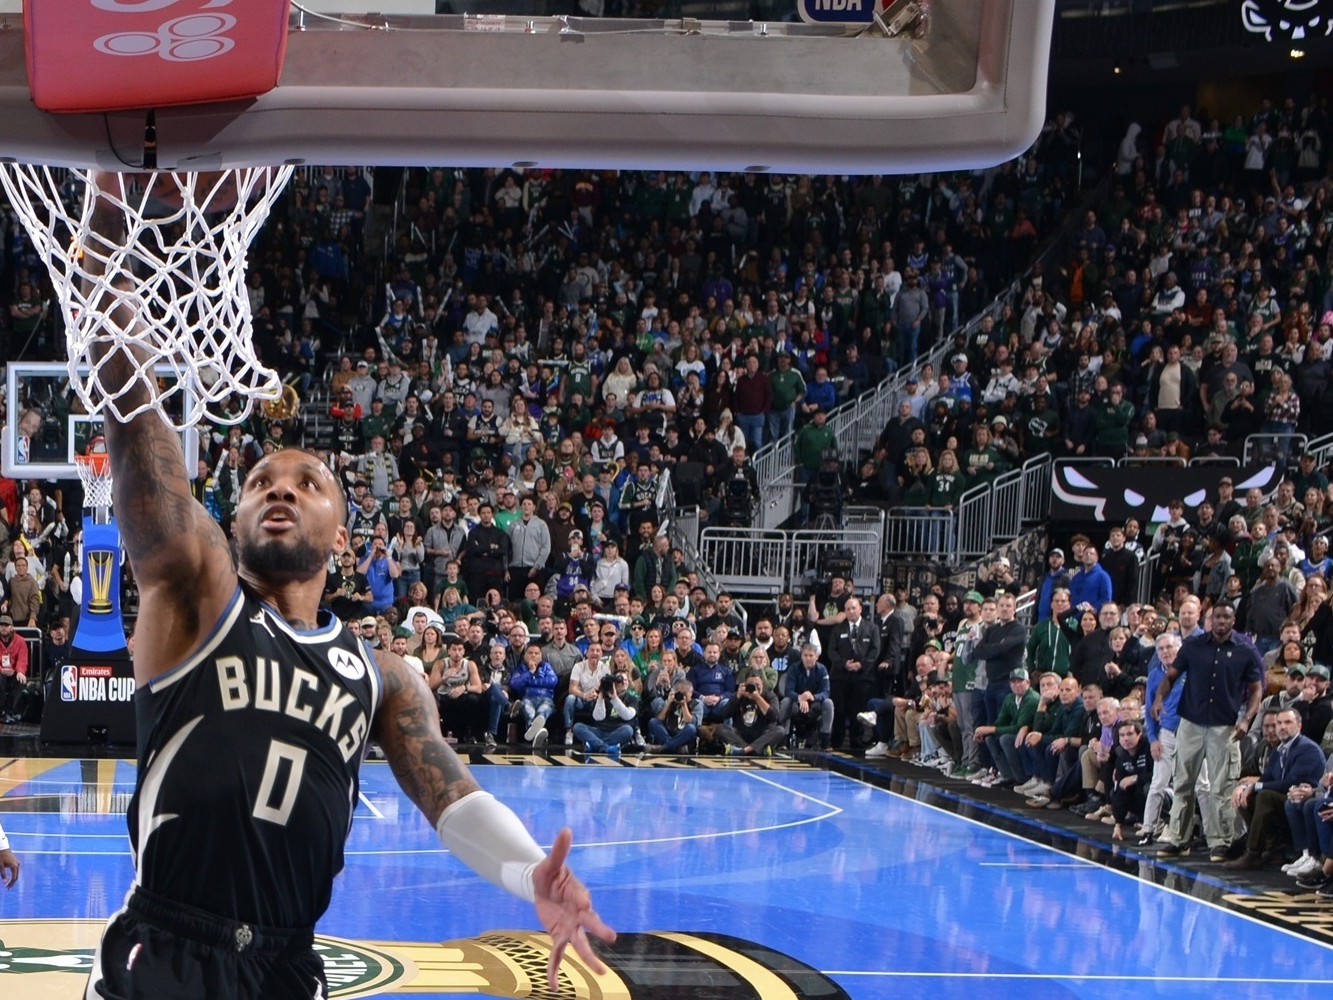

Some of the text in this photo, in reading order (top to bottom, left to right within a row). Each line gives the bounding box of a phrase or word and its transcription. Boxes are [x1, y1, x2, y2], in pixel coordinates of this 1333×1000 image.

[78, 676, 136, 702] NBA CUP
[81, 667, 111, 675] Emirates
[215, 655, 367, 764] BUCKS
[252, 738, 308, 827] 0
